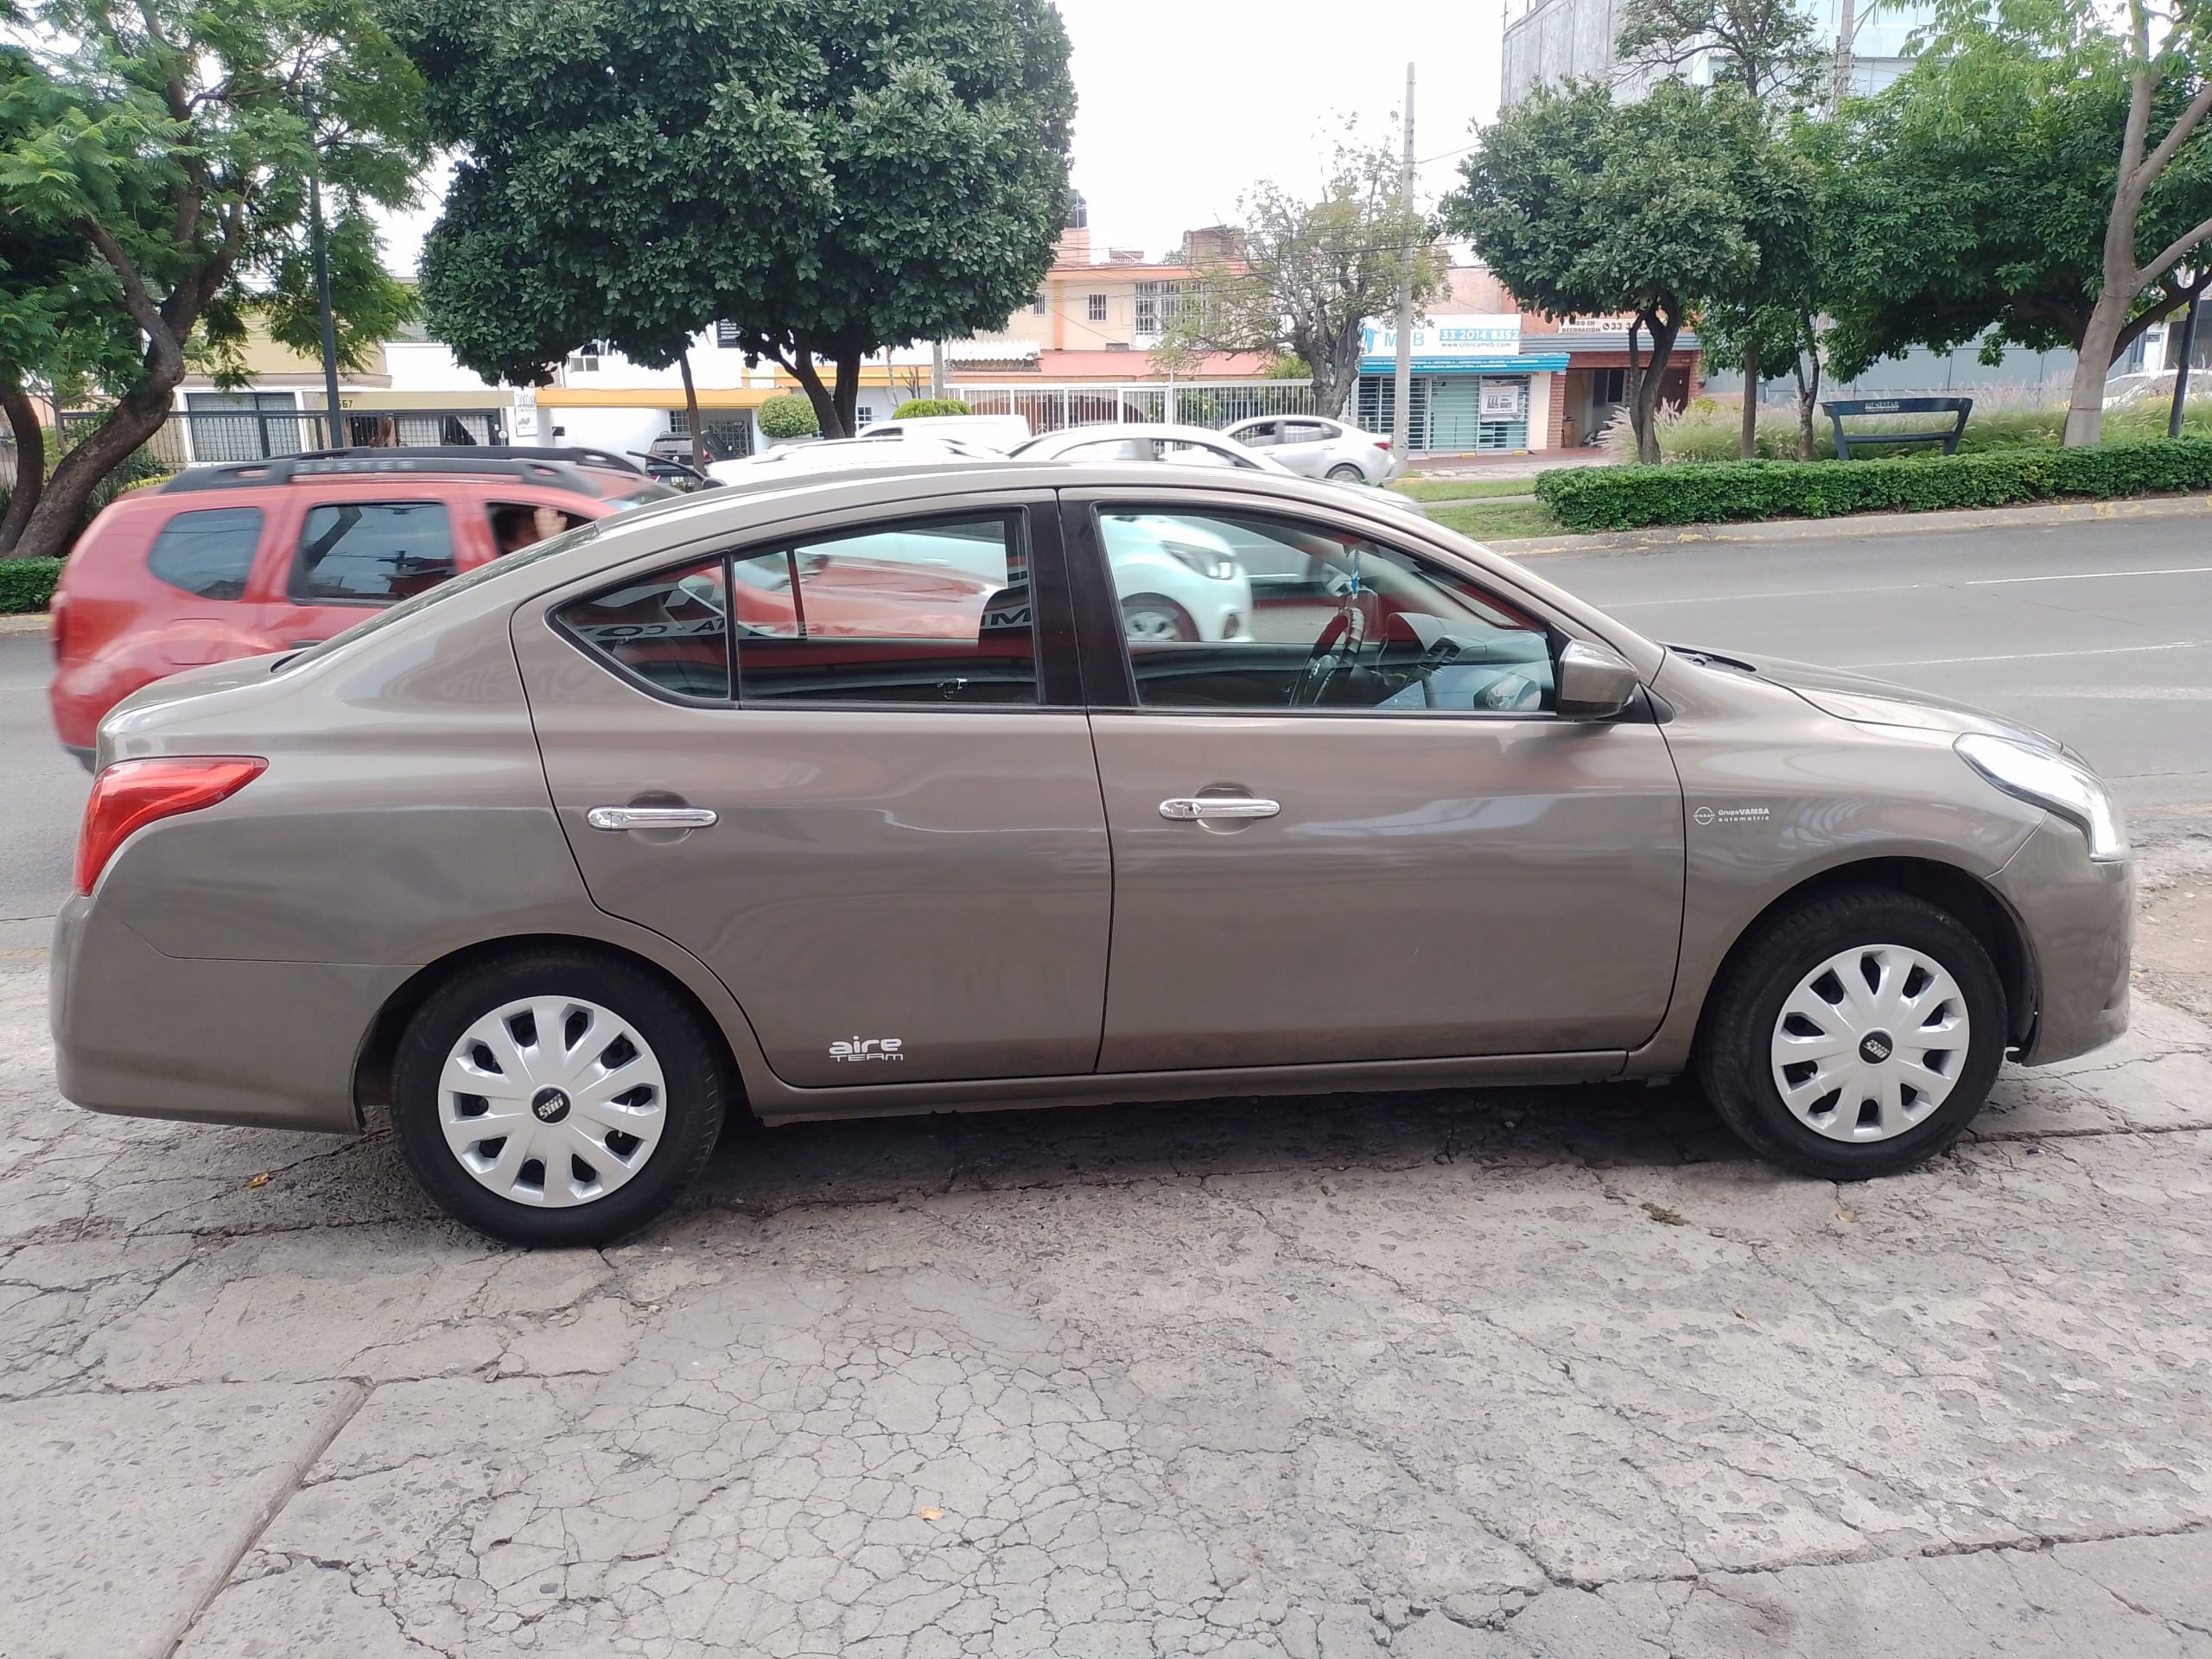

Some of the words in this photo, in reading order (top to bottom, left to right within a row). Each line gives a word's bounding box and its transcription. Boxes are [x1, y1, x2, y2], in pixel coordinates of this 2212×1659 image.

[1384, 332, 1425, 346] MB
[1441, 329, 1456, 340] 33
[1459, 329, 1487, 340] 2014
[295, 461, 416, 473] DUSTER
[829, 1035, 902, 1054] aire
[829, 1053, 904, 1063] TEAM
